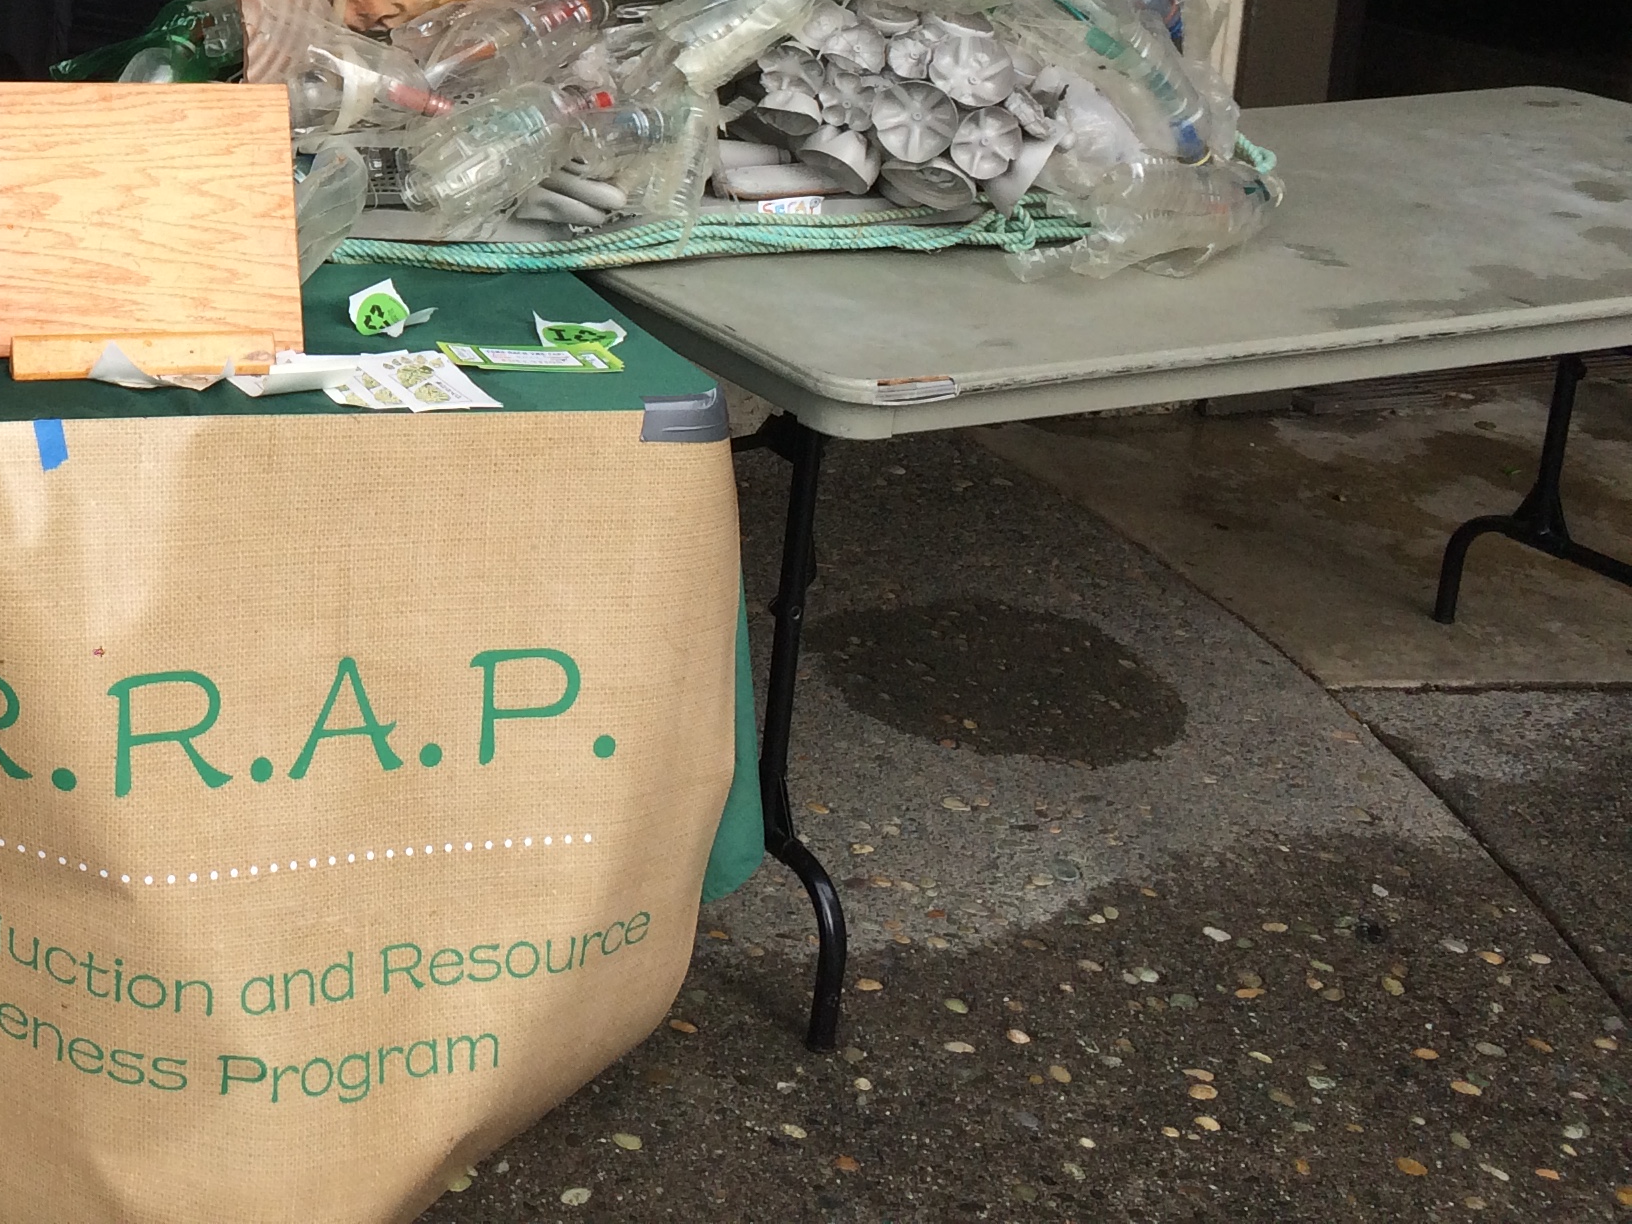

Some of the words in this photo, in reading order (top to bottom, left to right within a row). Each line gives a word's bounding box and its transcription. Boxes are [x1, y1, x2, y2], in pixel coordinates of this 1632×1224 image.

[241, 951, 355, 1016] and
[380, 911, 651, 994] Resource
[217, 1032, 500, 1104] Program
